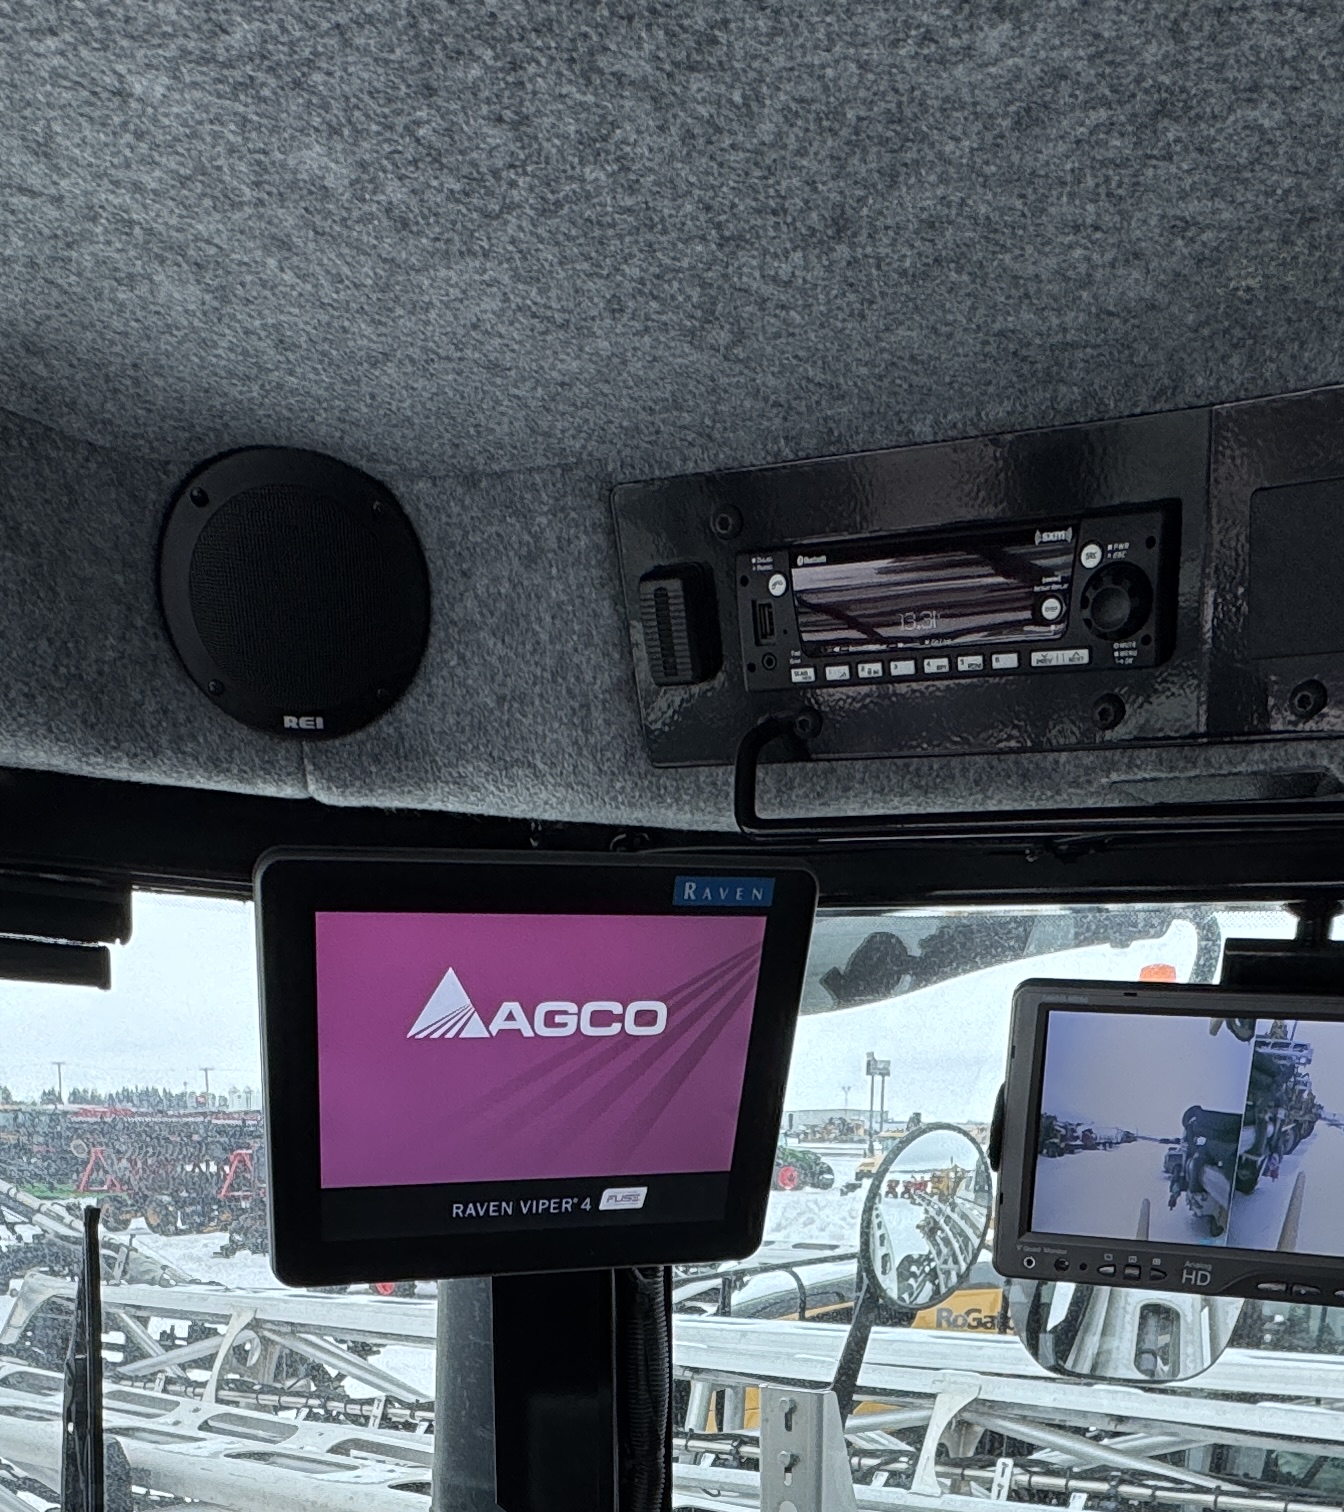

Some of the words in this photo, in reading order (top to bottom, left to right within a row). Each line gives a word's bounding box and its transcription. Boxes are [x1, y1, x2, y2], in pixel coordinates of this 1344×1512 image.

[283, 715, 324, 730] REI
[488, 1000, 668, 1038] AGCO
[452, 1201, 514, 1218] RAVEN
[580, 1197, 592, 1212] 4
[1181, 1269, 1212, 1287] HD
